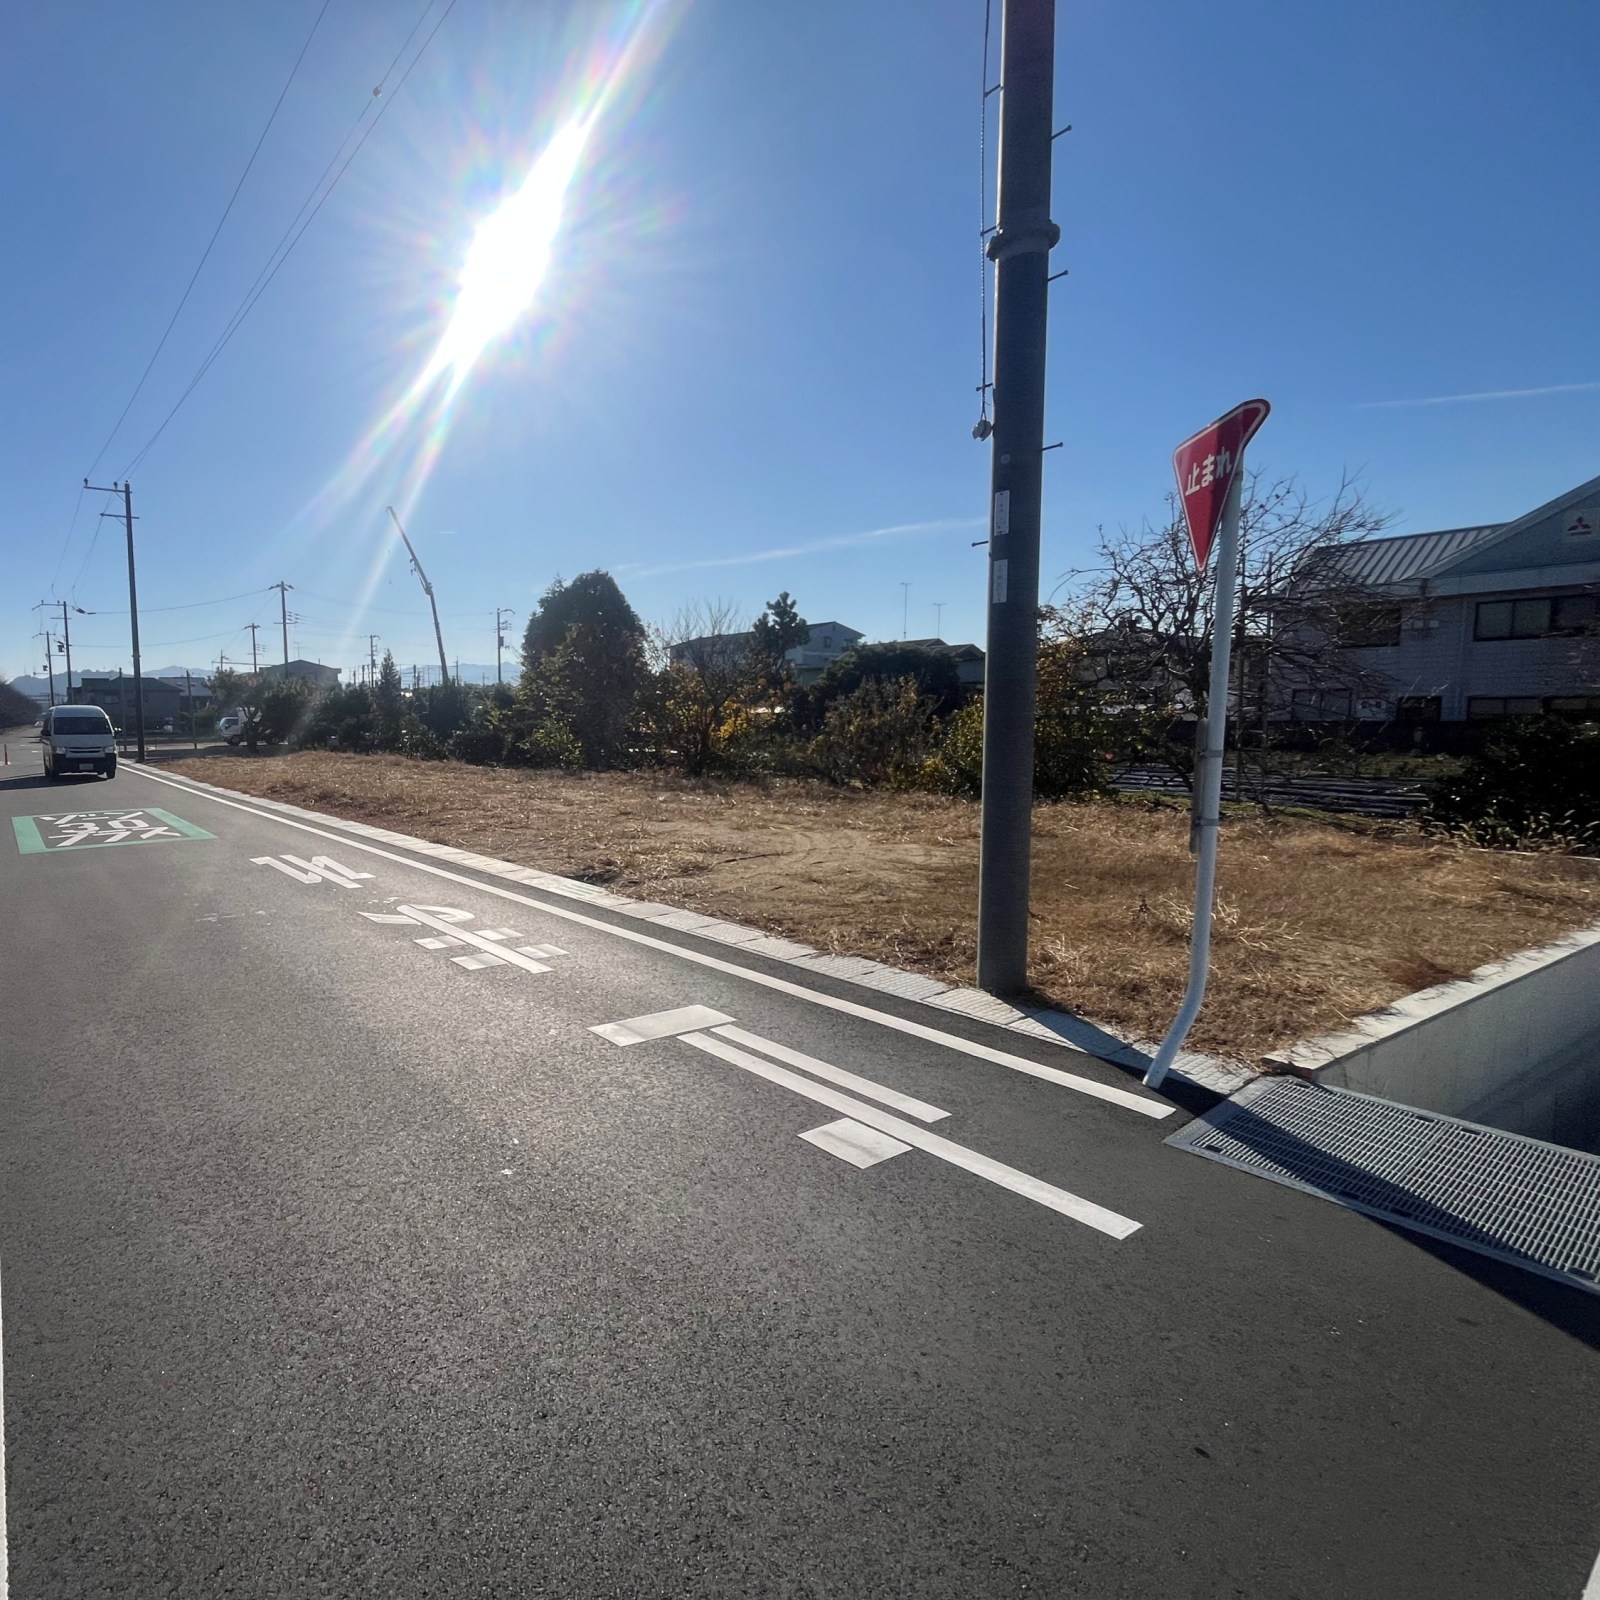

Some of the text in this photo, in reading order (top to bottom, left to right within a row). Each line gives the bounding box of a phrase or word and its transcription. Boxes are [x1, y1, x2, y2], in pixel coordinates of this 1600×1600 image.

[1185, 446, 1232, 496] 止まれ
[40, 811, 144, 824] ゾーン
[58, 819, 150, 833] 30
[48, 827, 182, 847] プラス
[249, 854, 1143, 1240] 止まれ
